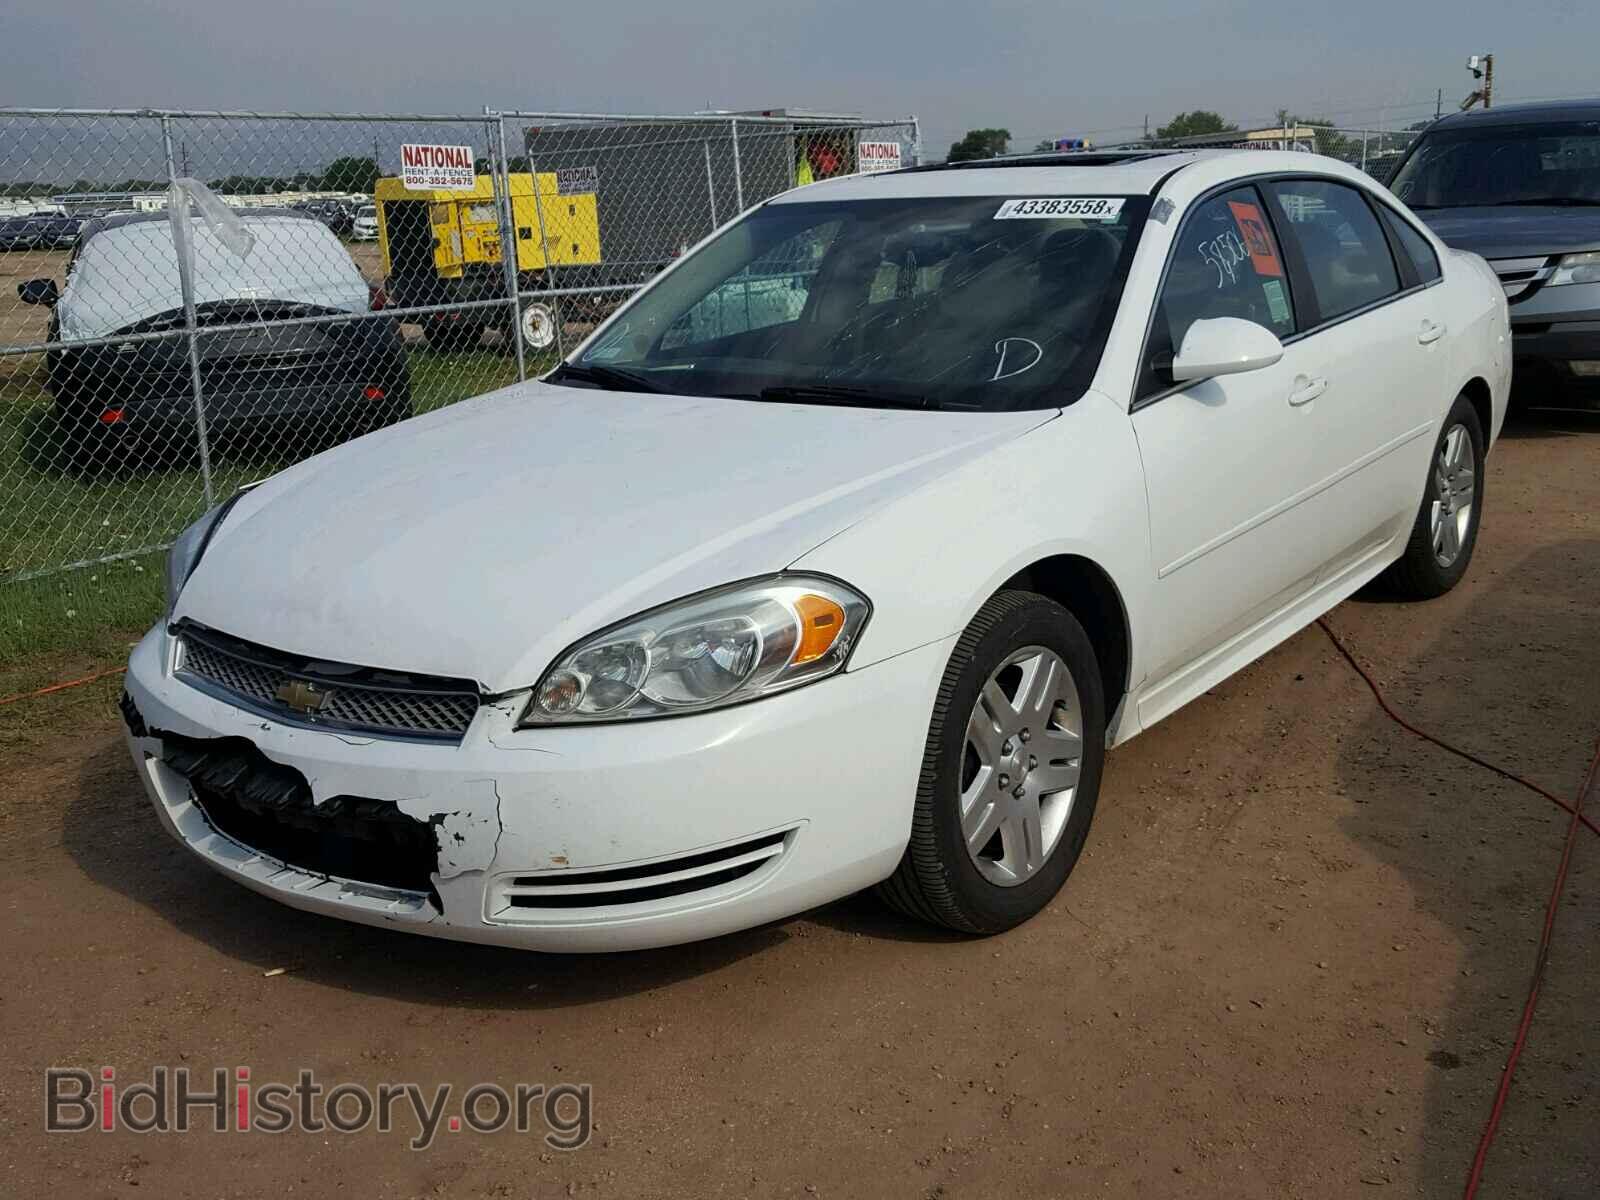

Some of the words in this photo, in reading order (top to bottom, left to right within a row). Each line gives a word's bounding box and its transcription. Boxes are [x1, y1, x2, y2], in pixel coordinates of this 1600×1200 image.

[403, 146, 472, 168] NATIONAL
[860, 144, 899, 158] NATIONAL
[406, 177, 473, 185] 800-352-5675
[986, 337, 1043, 382] D
